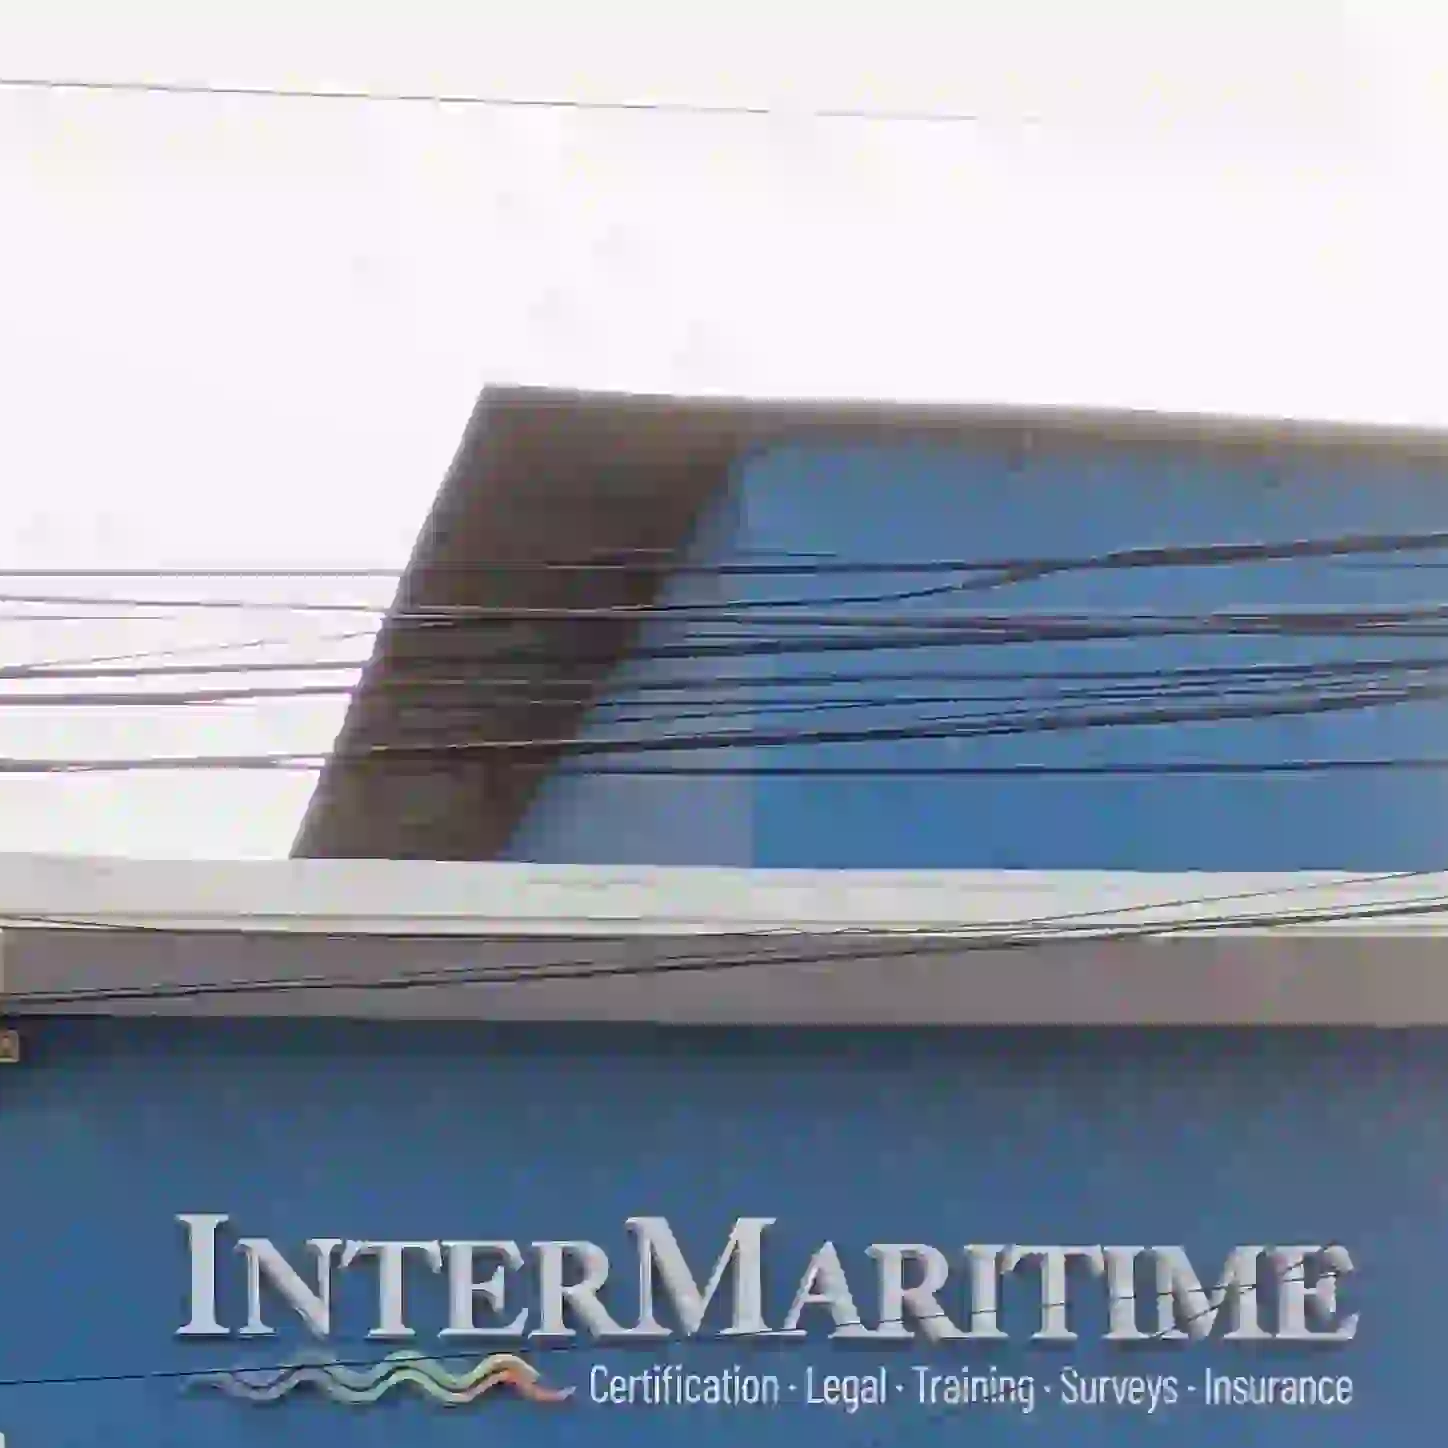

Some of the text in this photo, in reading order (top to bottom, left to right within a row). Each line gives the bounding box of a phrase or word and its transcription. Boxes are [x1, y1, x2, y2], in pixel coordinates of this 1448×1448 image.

[174, 1211, 1360, 1342] INTERMARITIME
[588, 1362, 1354, 1413] Certification Legal Training Surveys Insurance
